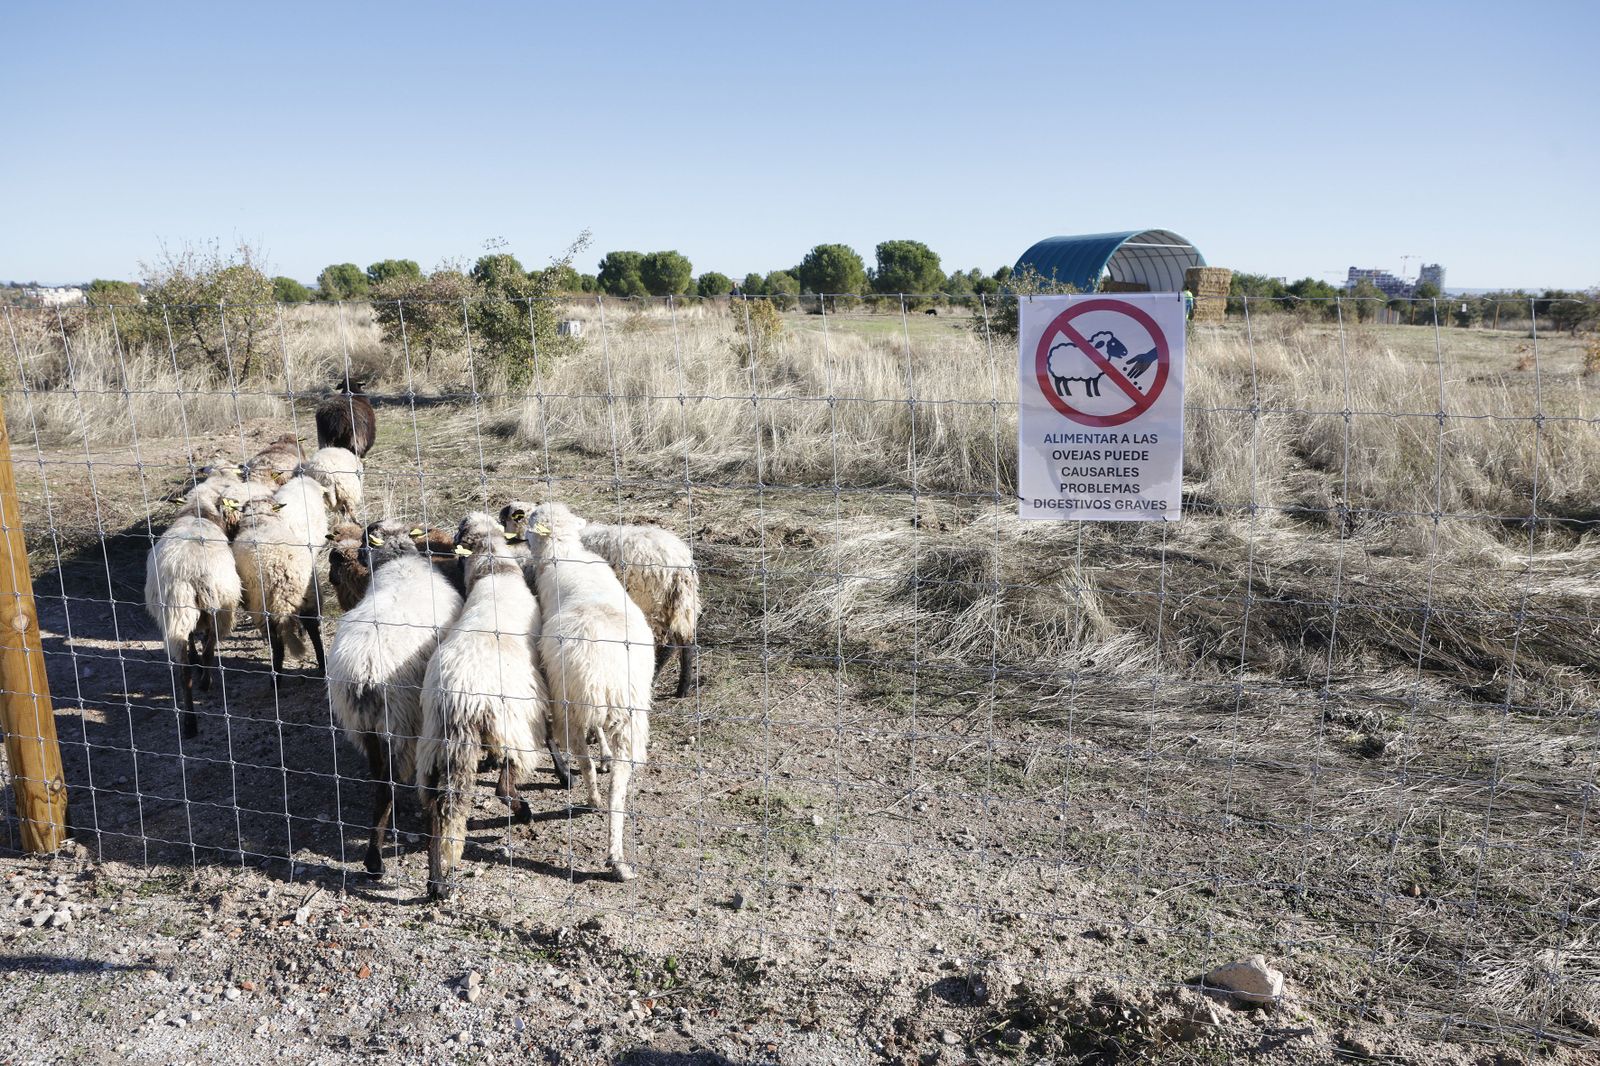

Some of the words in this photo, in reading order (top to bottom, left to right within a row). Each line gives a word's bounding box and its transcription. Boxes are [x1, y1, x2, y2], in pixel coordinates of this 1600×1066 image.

[1043, 433, 1118, 444] ALIMENTAR
[1120, 433, 1130, 444] A
[1133, 433, 1159, 444] LAS
[1051, 450, 1101, 461] OVEJAS
[1104, 450, 1149, 461] PUEDE
[1061, 466, 1140, 478] CAUSARLES
[1060, 483, 1141, 494] PROBLEMAS
[1033, 499, 1112, 510] DIGESTIVOS
[1114, 499, 1167, 510] GRAVES
